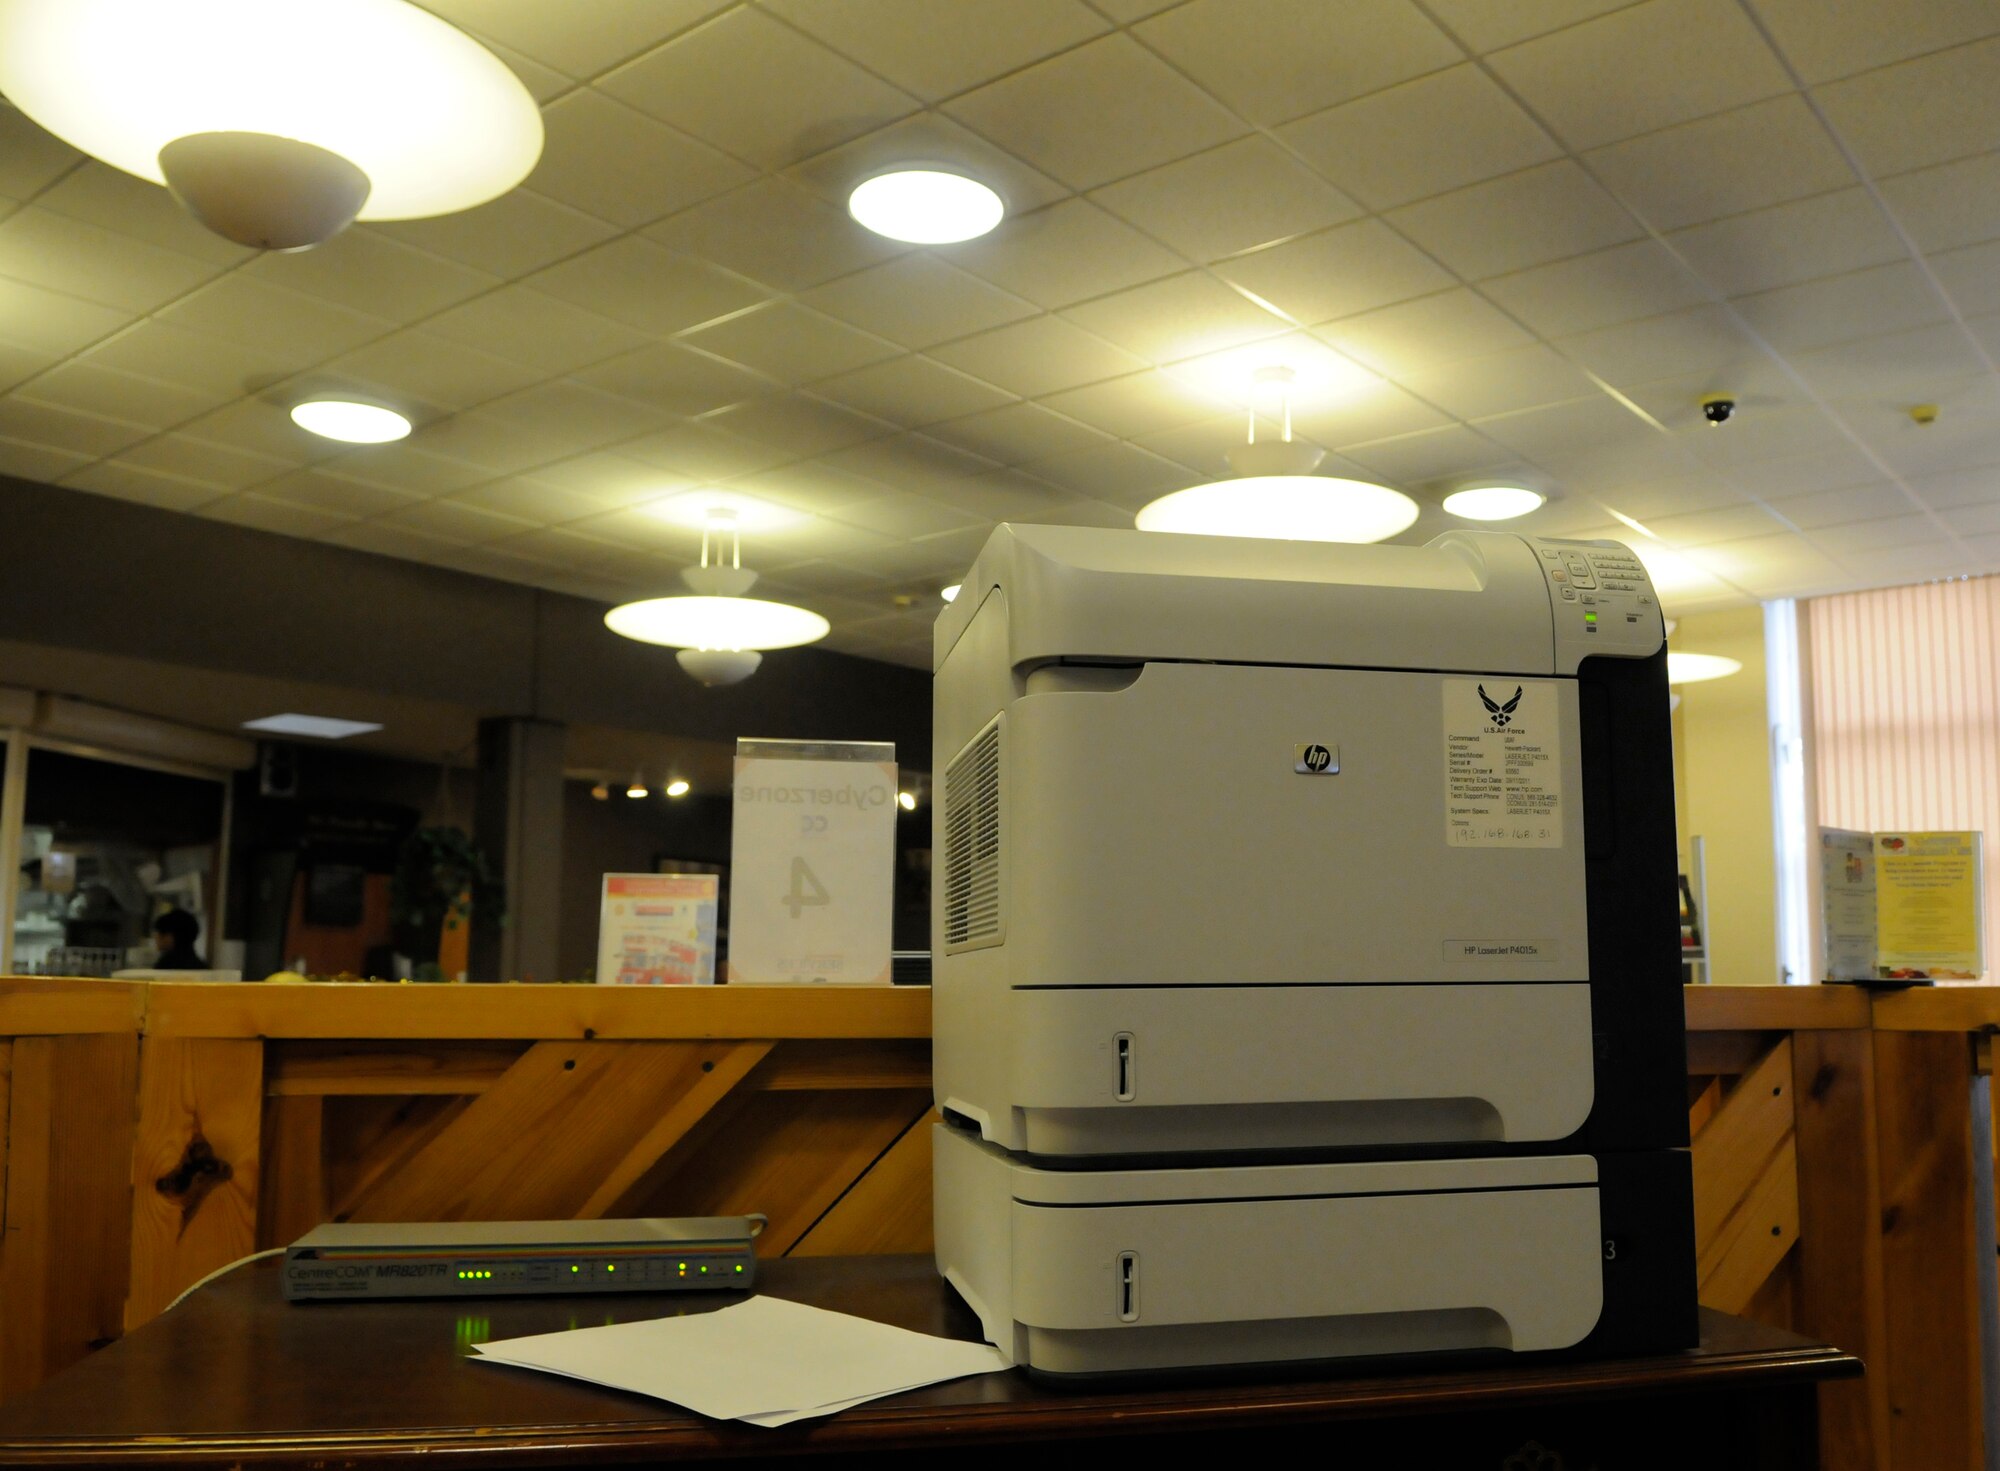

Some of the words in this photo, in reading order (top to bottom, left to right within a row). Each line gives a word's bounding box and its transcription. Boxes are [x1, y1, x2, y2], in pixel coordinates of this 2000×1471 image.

[1306, 744, 1329, 772] hp
[1449, 776, 1475, 784] Warranty
[1476, 776, 1488, 784] Exp
[1464, 945, 1476, 955] HP
[1477, 945, 1509, 955] LaserJet
[1510, 945, 1538, 955] P4015x
[1605, 1239, 1616, 1260] 3
